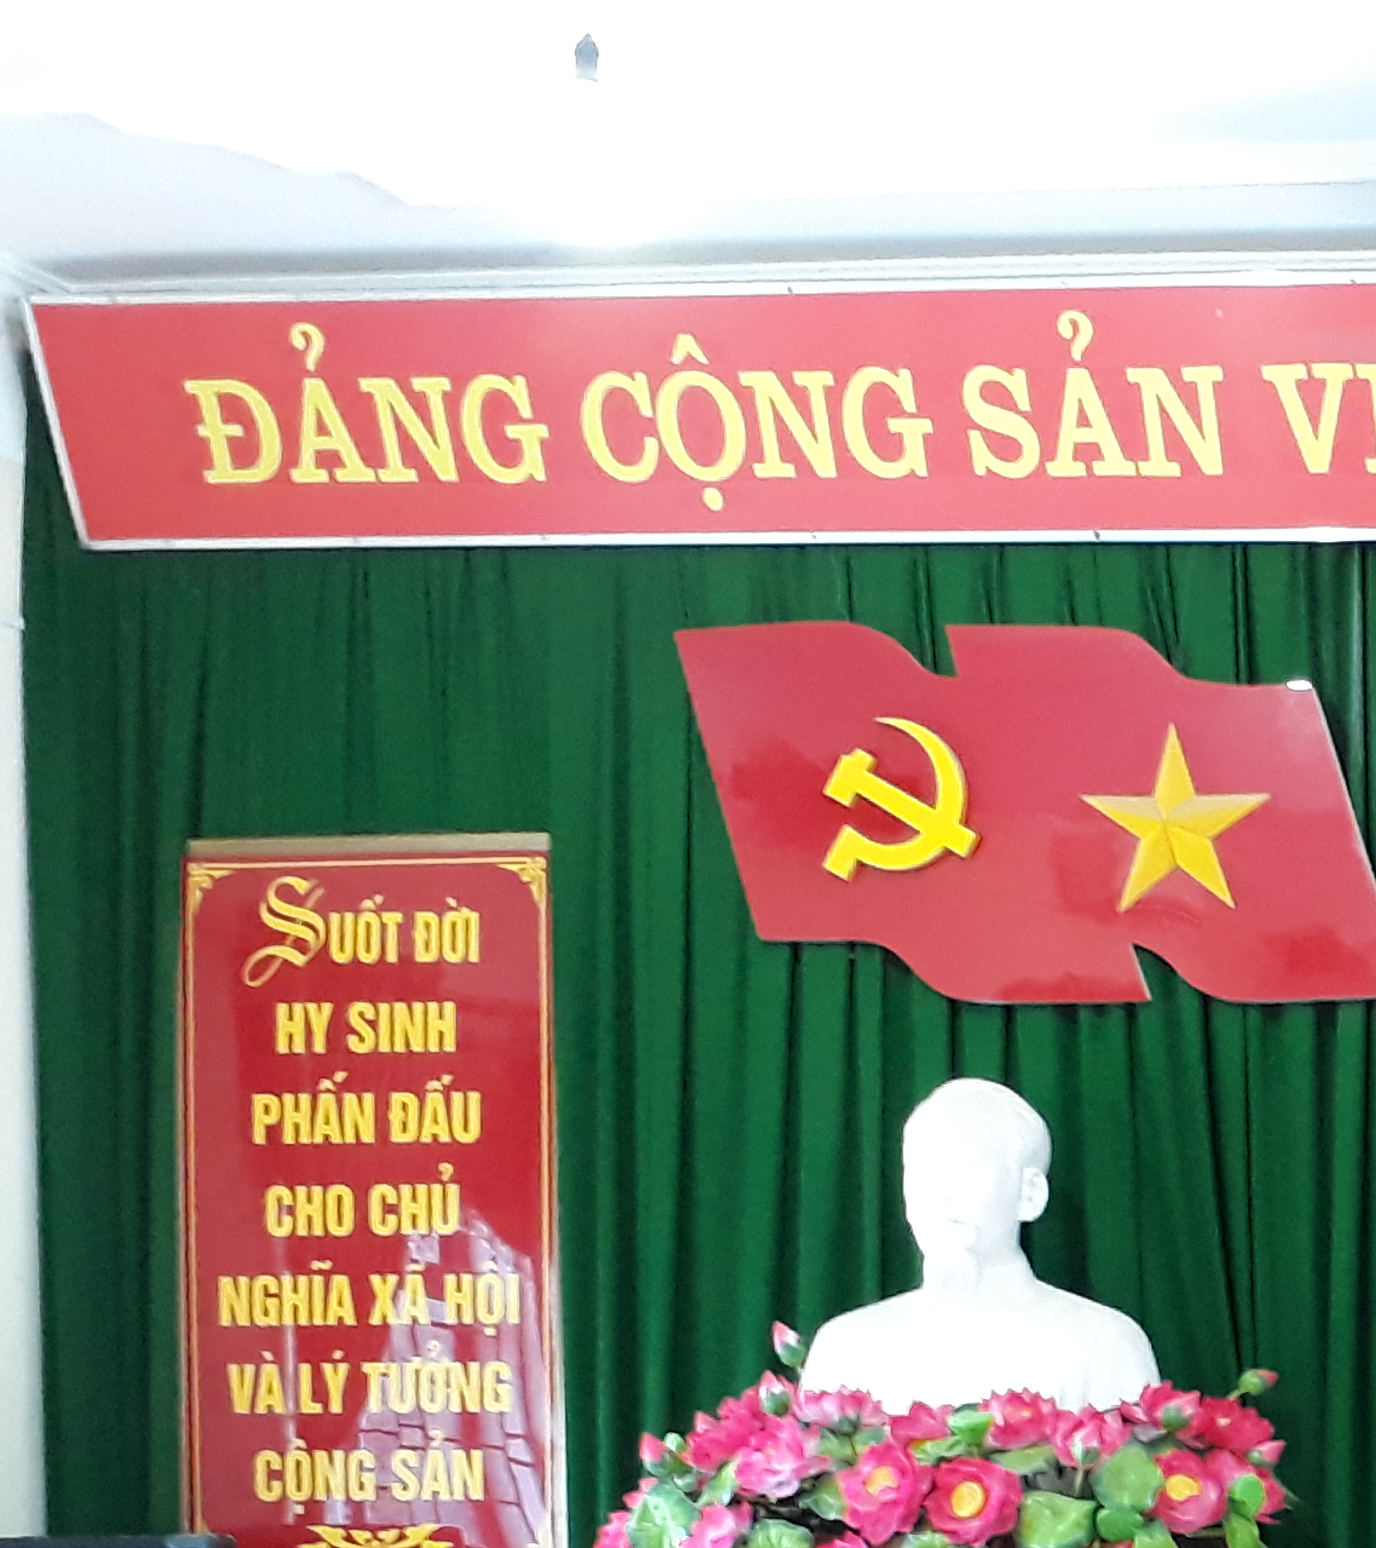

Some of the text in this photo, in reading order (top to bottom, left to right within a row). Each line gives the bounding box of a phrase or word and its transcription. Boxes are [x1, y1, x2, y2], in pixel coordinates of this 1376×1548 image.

[186, 322, 548, 485] ĐẢNG
[581, 334, 933, 508] CỘNG
[963, 310, 1223, 478] SẢN
[241, 876, 481, 988] SUỐT ĐỜI
[274, 1001, 458, 1055] HY SINH
[251, 1070, 482, 1145] PHẤN ĐẤU
[263, 1162, 461, 1238] CHO CHỦ
[217, 1260, 520, 1336] NGHĨA XÃ HỘI
[226, 1340, 514, 1414] VÀ LÝ TƯỞNG
[253, 1429, 485, 1515] CỘNG SẢN
